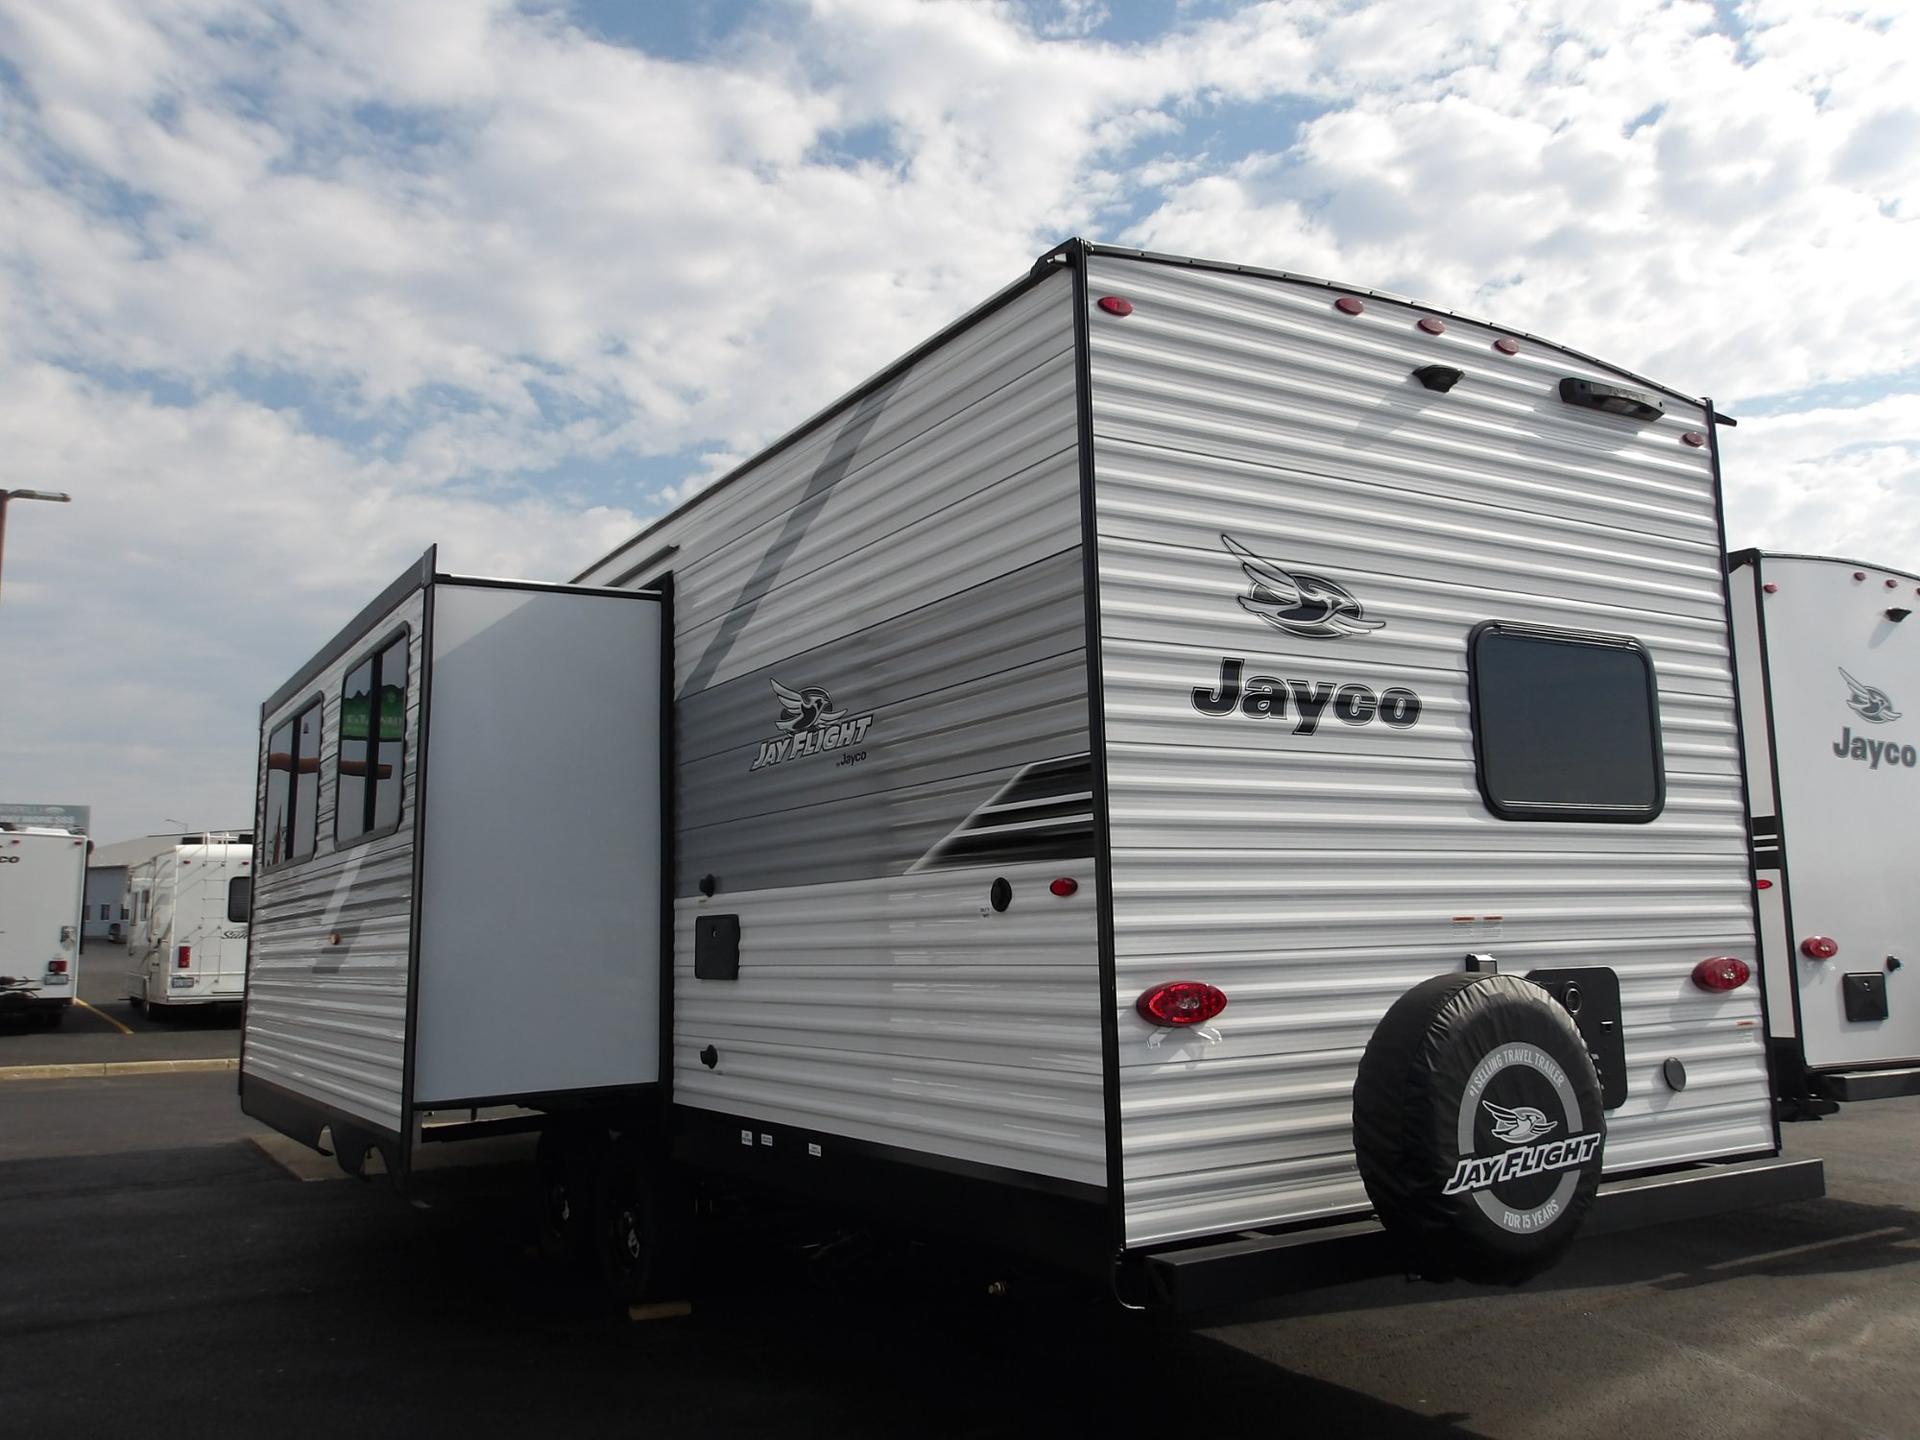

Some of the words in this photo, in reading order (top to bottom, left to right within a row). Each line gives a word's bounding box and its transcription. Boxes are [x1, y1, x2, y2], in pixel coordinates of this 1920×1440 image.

[1190, 656, 1422, 735] Jayco
[840, 751, 867, 766] Jayco
[1832, 726, 1917, 770] Jayco
[1474, 1054, 1503, 1088] SELLING
[1503, 1048, 1533, 1064] TRAVEL
[1534, 1052, 1565, 1087] TRAILER
[1503, 1211, 1520, 1229] FOR
[1521, 1214, 1532, 1229] 15
[1532, 1199, 1560, 1226] YEARS
